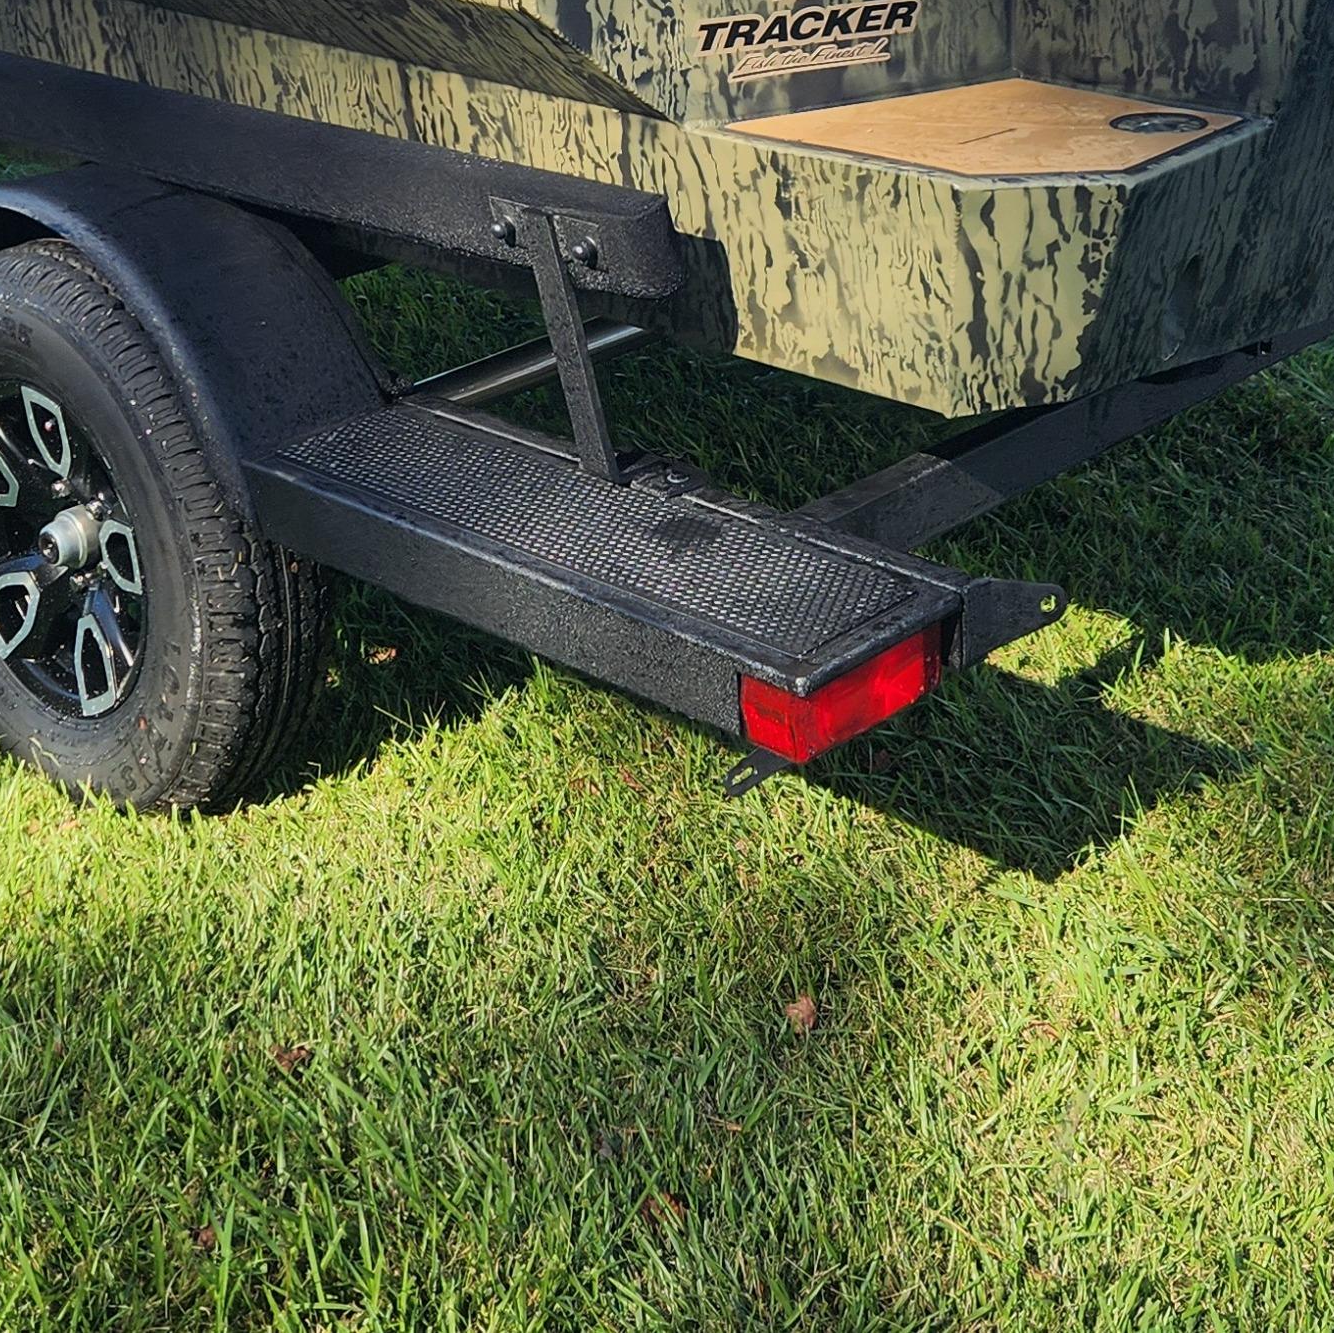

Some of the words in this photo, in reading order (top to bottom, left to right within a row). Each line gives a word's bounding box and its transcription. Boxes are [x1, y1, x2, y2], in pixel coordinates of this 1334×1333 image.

[699, 0, 918, 52] TRACKER
[738, 52, 778, 71] Fish
[780, 47, 809, 66] the
